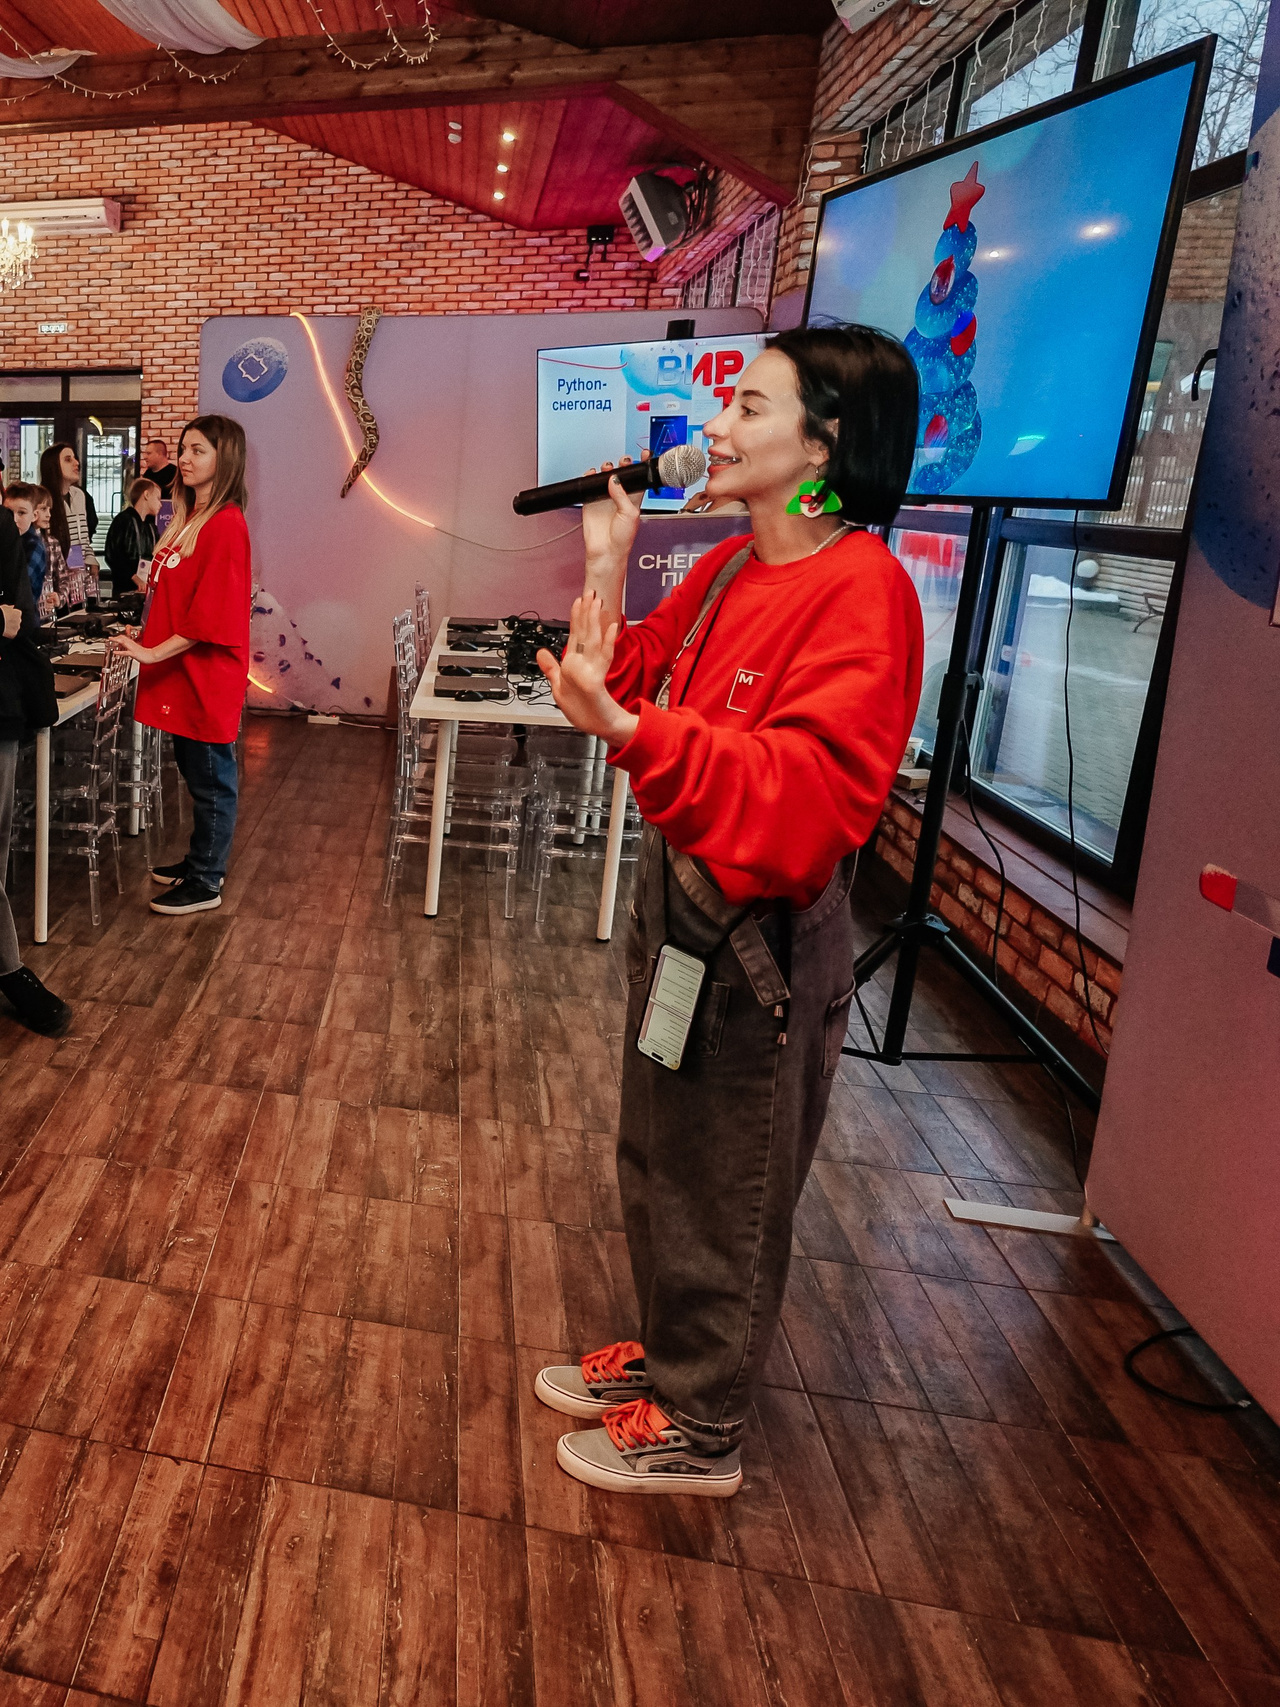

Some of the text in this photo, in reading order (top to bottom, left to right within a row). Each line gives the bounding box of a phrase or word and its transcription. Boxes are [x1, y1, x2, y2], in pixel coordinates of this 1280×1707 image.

[557, 377, 607, 395] Python-
[552, 399, 612, 412] снегопад
[638, 553, 702, 570] СНЕГ
